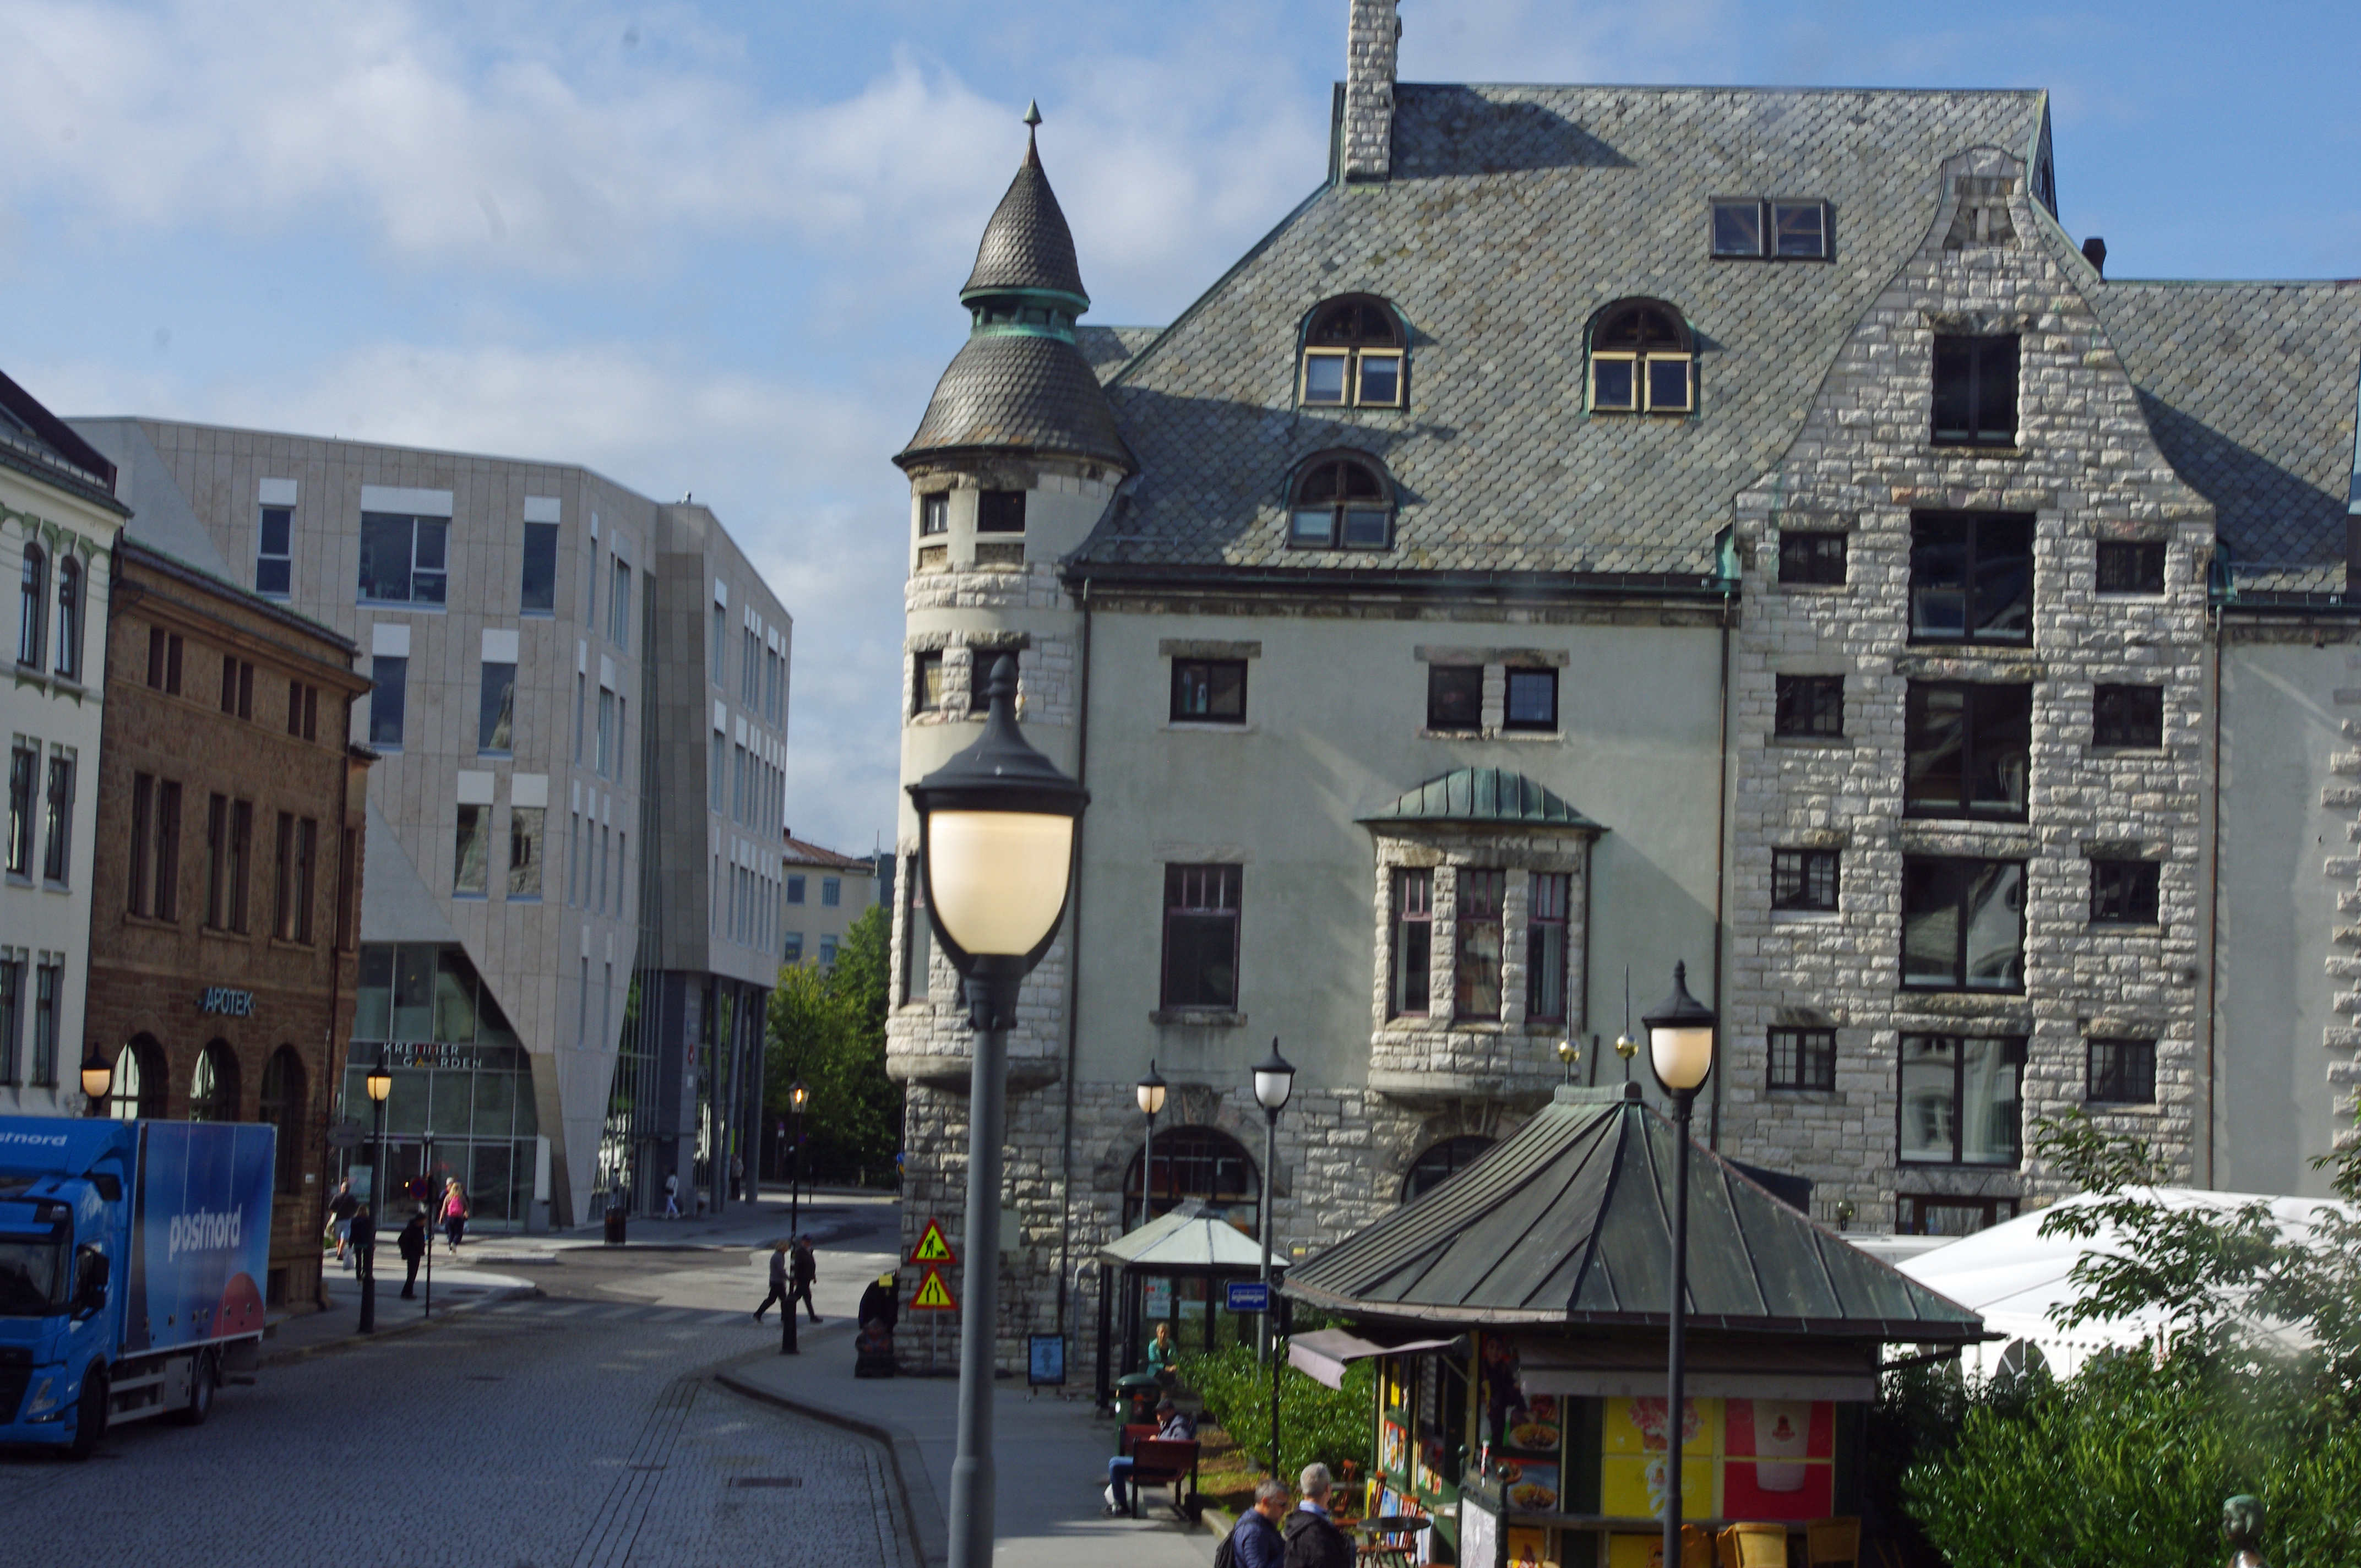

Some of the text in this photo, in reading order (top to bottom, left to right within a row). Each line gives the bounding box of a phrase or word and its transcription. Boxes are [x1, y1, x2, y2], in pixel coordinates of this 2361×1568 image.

[204, 986, 254, 1017] APOTEK
[383, 1042, 459, 1056] KREMMER
[403, 1055, 482, 1069] GAARDEN
[168, 1202, 242, 1263] postnord
